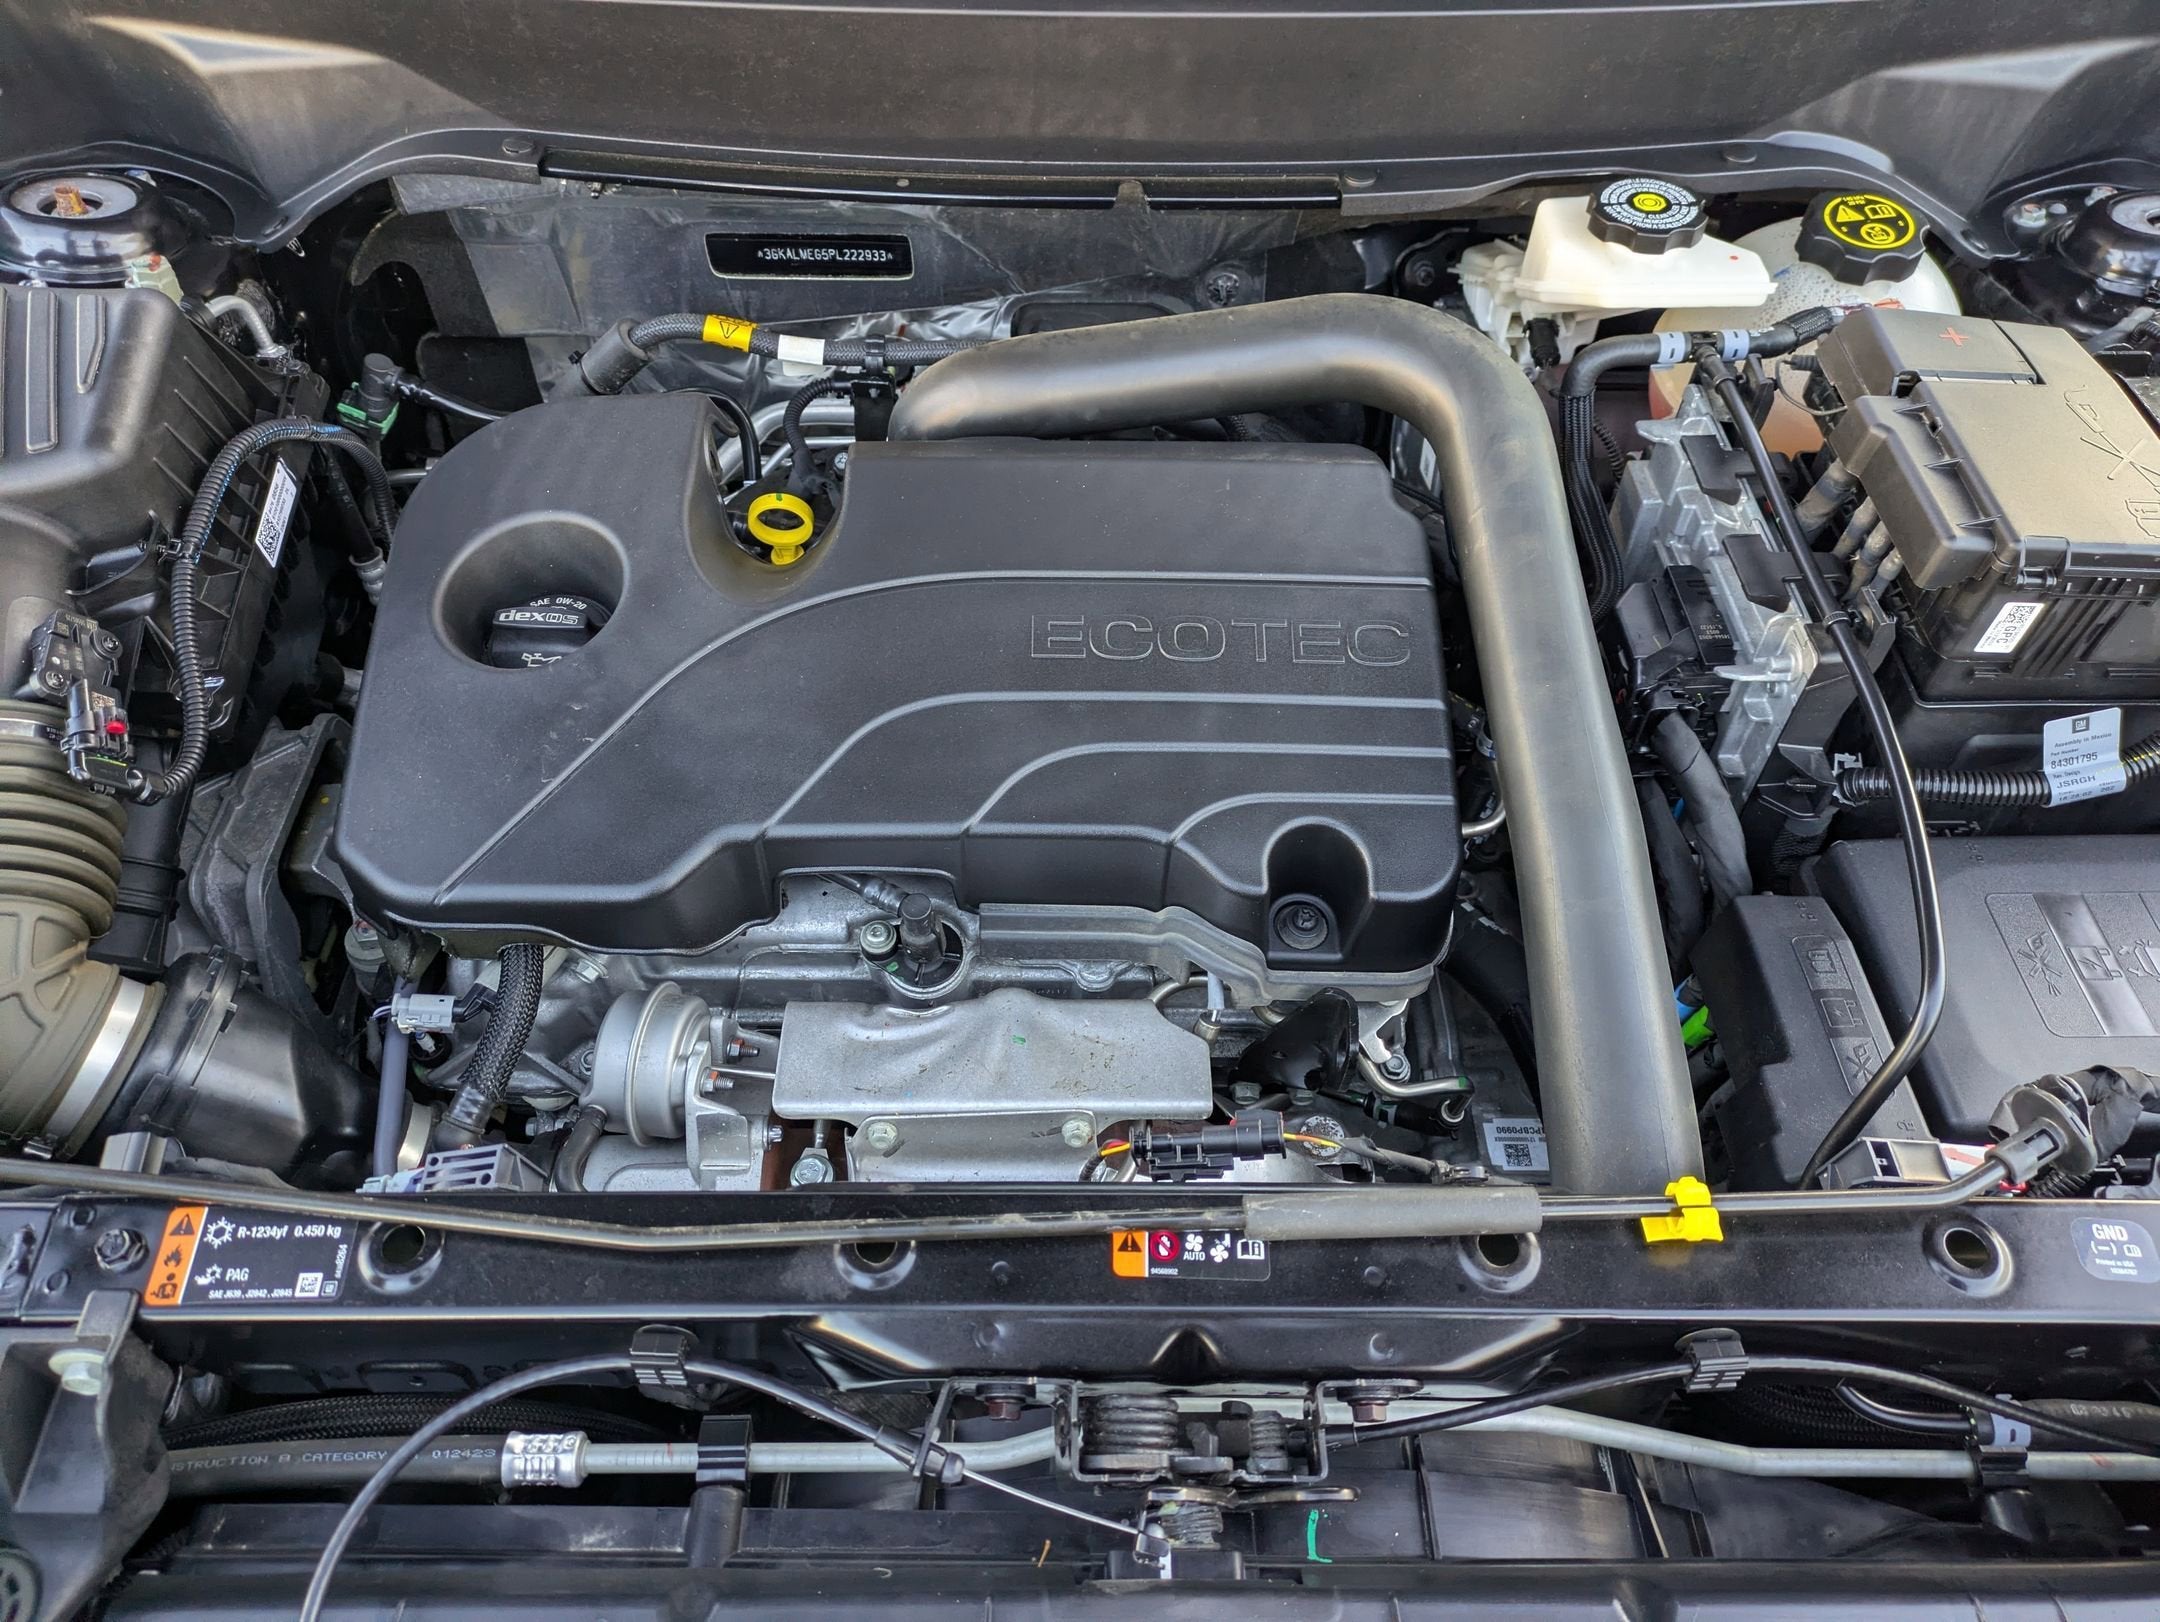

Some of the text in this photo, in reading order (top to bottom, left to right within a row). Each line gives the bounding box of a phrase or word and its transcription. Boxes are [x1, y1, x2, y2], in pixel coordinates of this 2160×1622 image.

[530, 598, 551, 607] SAE
[1031, 614, 1411, 667] ECOTEC
[2050, 751, 2098, 769] 84301795
[2056, 775, 2096, 789] JSRGH
[238, 1225, 342, 1240] R-1234yf 0.450 kg
[2092, 1223, 2129, 1241] GND
[1183, 1251, 1206, 1261] AUTO
[226, 1268, 249, 1282] PAG
[302, 1450, 388, 1462] CATEGORY
